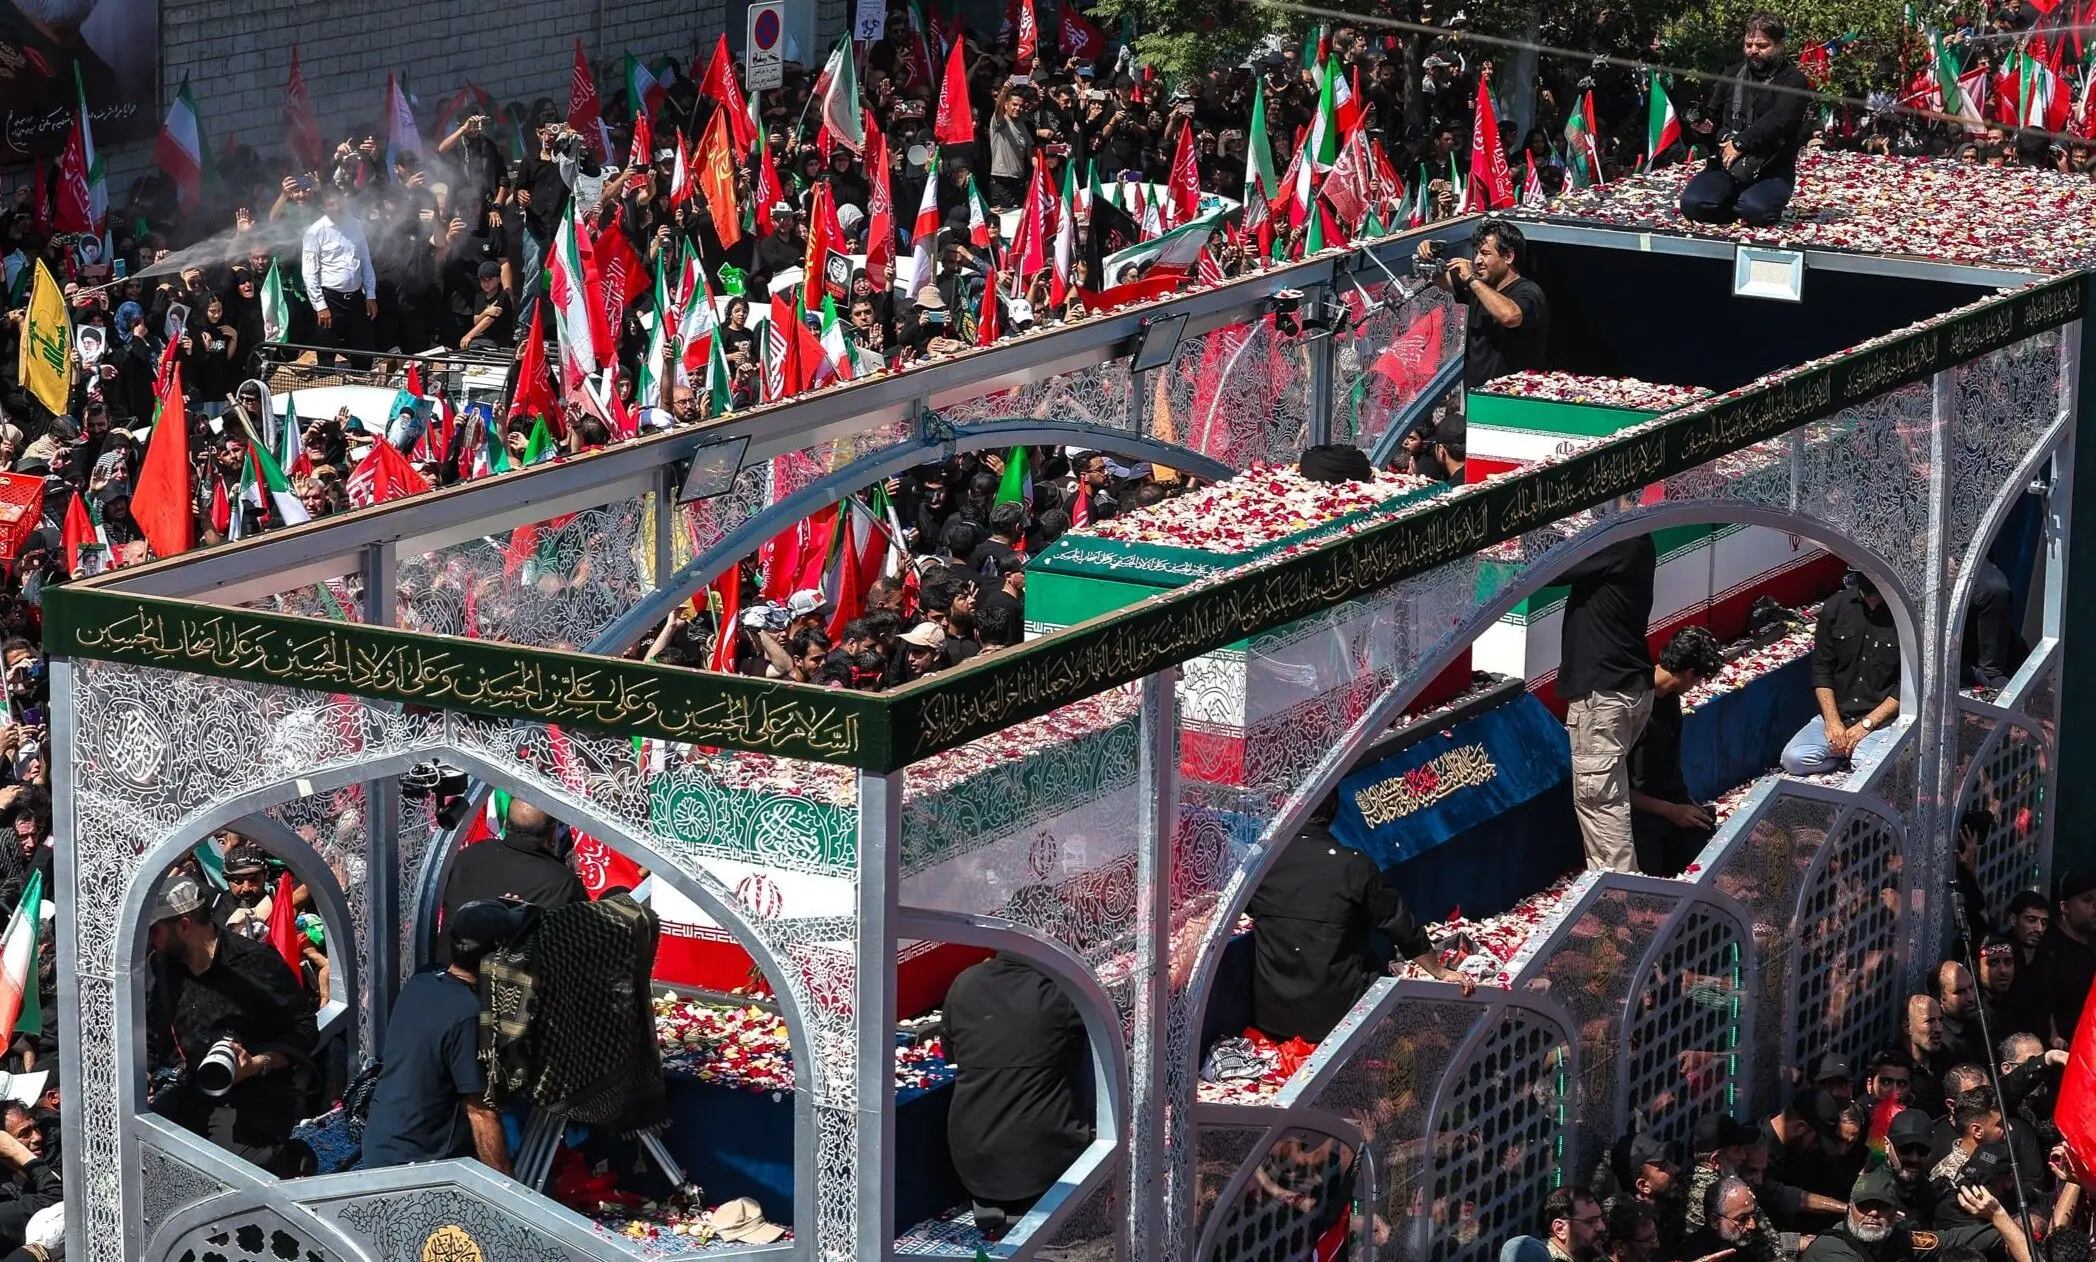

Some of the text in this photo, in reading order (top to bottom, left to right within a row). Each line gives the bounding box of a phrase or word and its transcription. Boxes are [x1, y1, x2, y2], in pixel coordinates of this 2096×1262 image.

[76, 605, 163, 656] الحسين
[264, 630, 351, 681] الحسين
[454, 660, 543, 708] الحسين
[660, 692, 749, 744] الحسين
[781, 708, 860, 757] السلام
